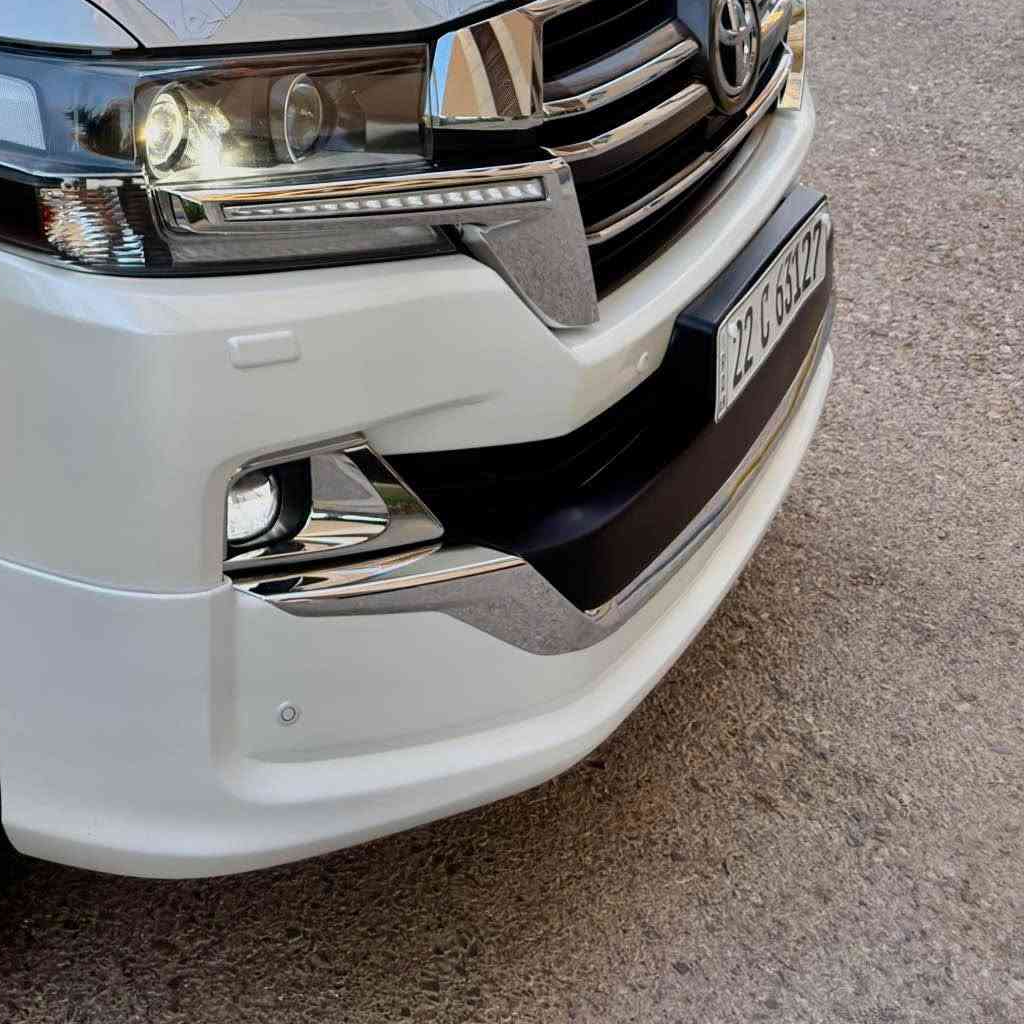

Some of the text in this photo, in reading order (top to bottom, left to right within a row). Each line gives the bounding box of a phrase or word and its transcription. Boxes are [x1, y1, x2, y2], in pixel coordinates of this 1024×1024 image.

[734, 220, 822, 389] 22 C 63127
